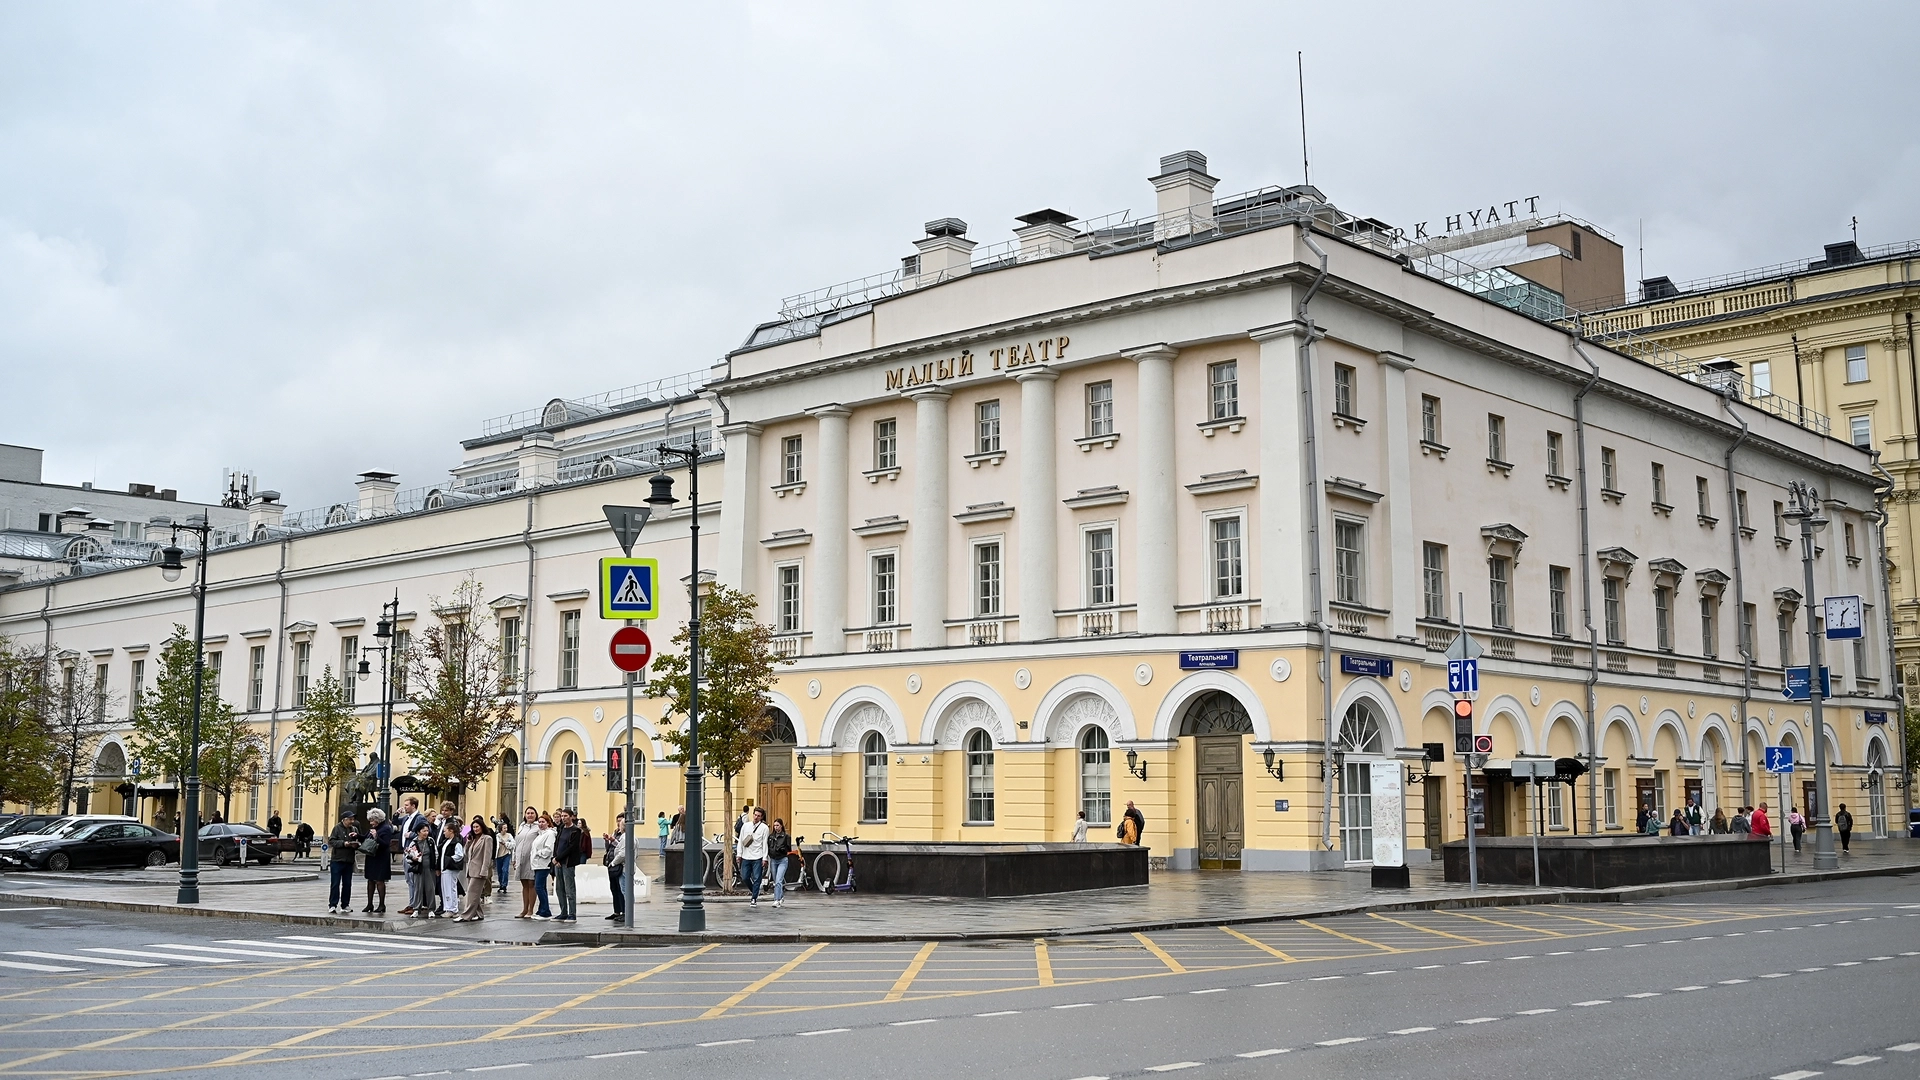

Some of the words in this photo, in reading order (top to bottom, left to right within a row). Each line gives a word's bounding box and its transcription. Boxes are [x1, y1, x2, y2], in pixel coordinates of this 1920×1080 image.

[1446, 195, 1540, 232] HYATT
[885, 350, 975, 391] МАЛЫЙ
[989, 336, 1070, 371] ТЕАТР
[1188, 654, 1228, 662] Театральная
[1386, 662, 1390, 674] 1
